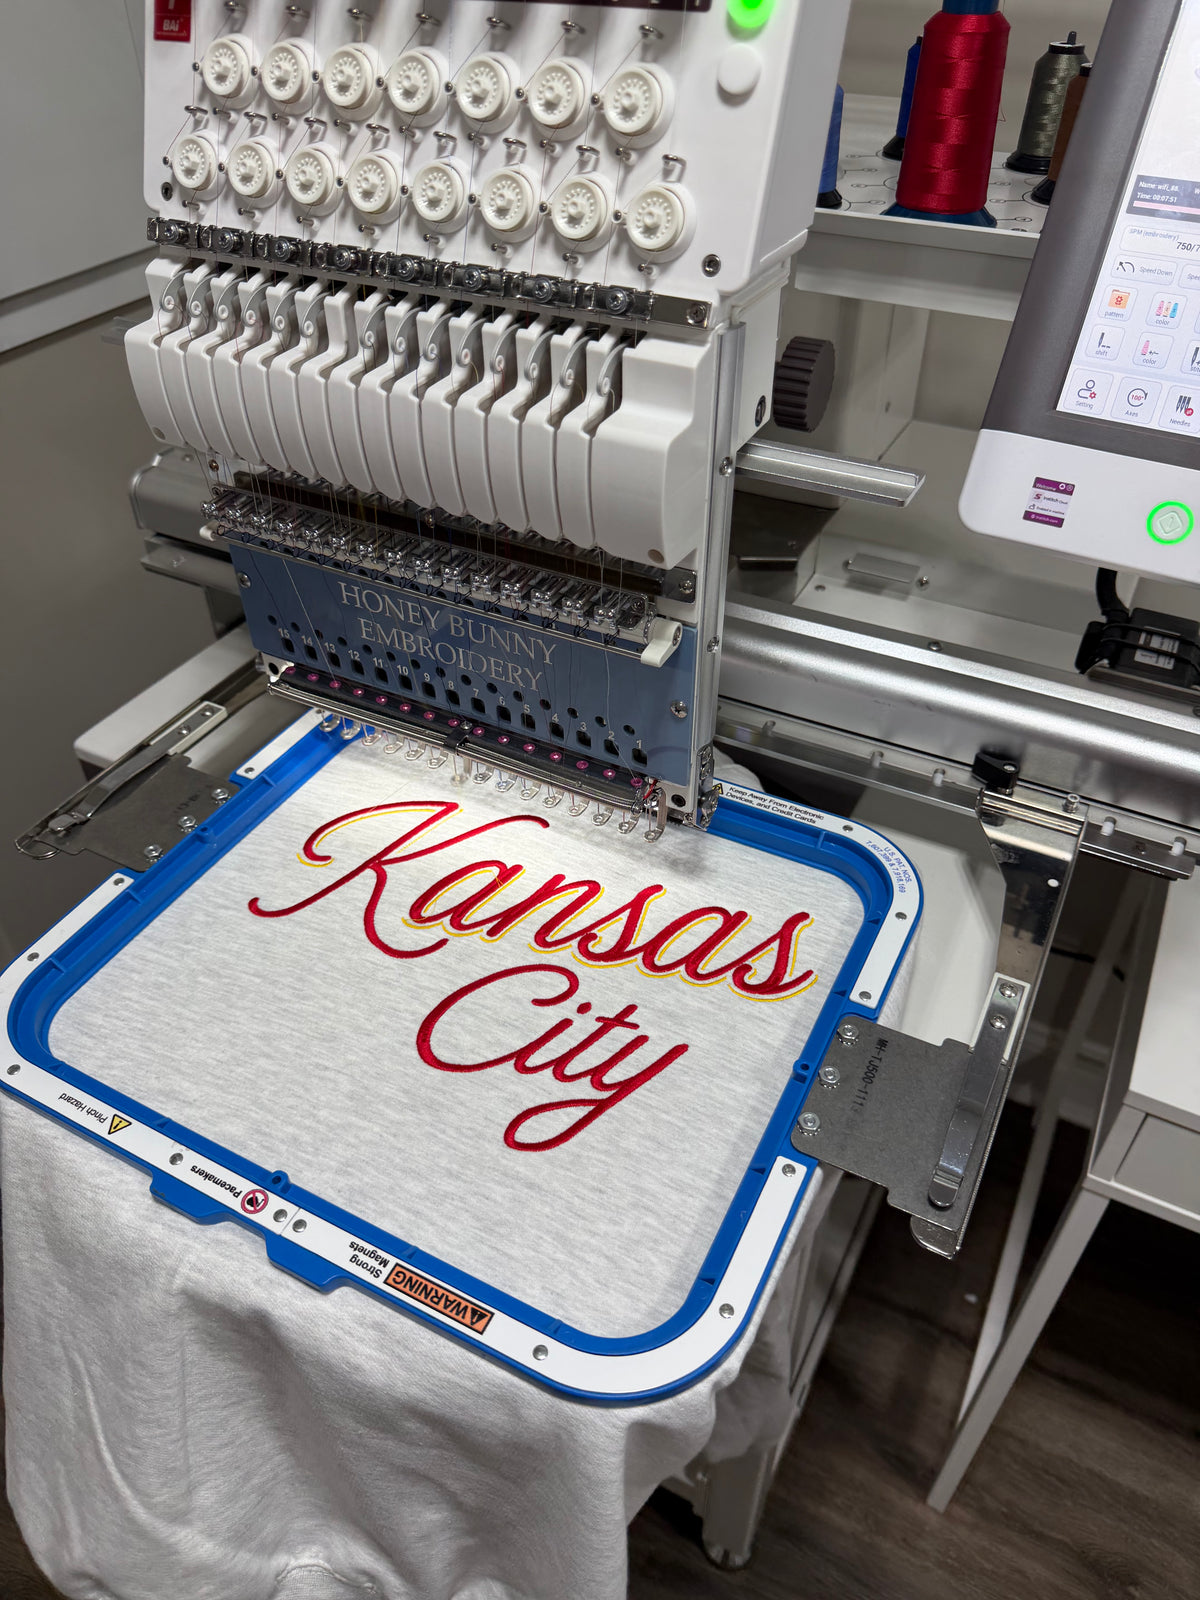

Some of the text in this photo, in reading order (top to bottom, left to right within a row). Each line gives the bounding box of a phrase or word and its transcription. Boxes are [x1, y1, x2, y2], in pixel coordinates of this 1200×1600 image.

[1139, 266, 1173, 277] Speed Down
[1104, 310, 1124, 319] pattern
[1095, 349, 1108, 357] shift
[1075, 400, 1094, 410] Setting
[1124, 410, 1139, 418] Axes
[1169, 418, 1191, 428] Needles
[338, 581, 557, 665] HONEY BUNNY
[278, 627, 291, 638] 15
[301, 635, 314, 647] 14
[324, 642, 336, 653] 13
[348, 650, 361, 661] 12
[358, 617, 543, 691] EMBROIDERY
[373, 657, 384, 668] 11
[397, 664, 410, 676] 10
[423, 672, 431, 682] 9
[448, 680, 455, 690] 8
[472, 688, 480, 698] 7
[499, 696, 506, 706] 6
[523, 704, 531, 714] 5
[551, 713, 560, 723] 4
[580, 722, 588, 732] 3
[608, 730, 616, 740] 2
[636, 739, 643, 749] 1
[725, 791, 817, 824] Devices, and Credit Cards
[729, 786, 825, 821] Keep Away From Electronic
[894, 858, 905, 869] PAT.
[248, 800, 819, 1001] Kansas
[416, 963, 690, 1152] City
[58, 1092, 108, 1123] Pinch Hazard
[190, 1164, 243, 1198] Pacemakers
[349, 1240, 390, 1268] Magnets
[349, 1253, 383, 1279] Strong
[392, 1270, 470, 1320] WARNING
